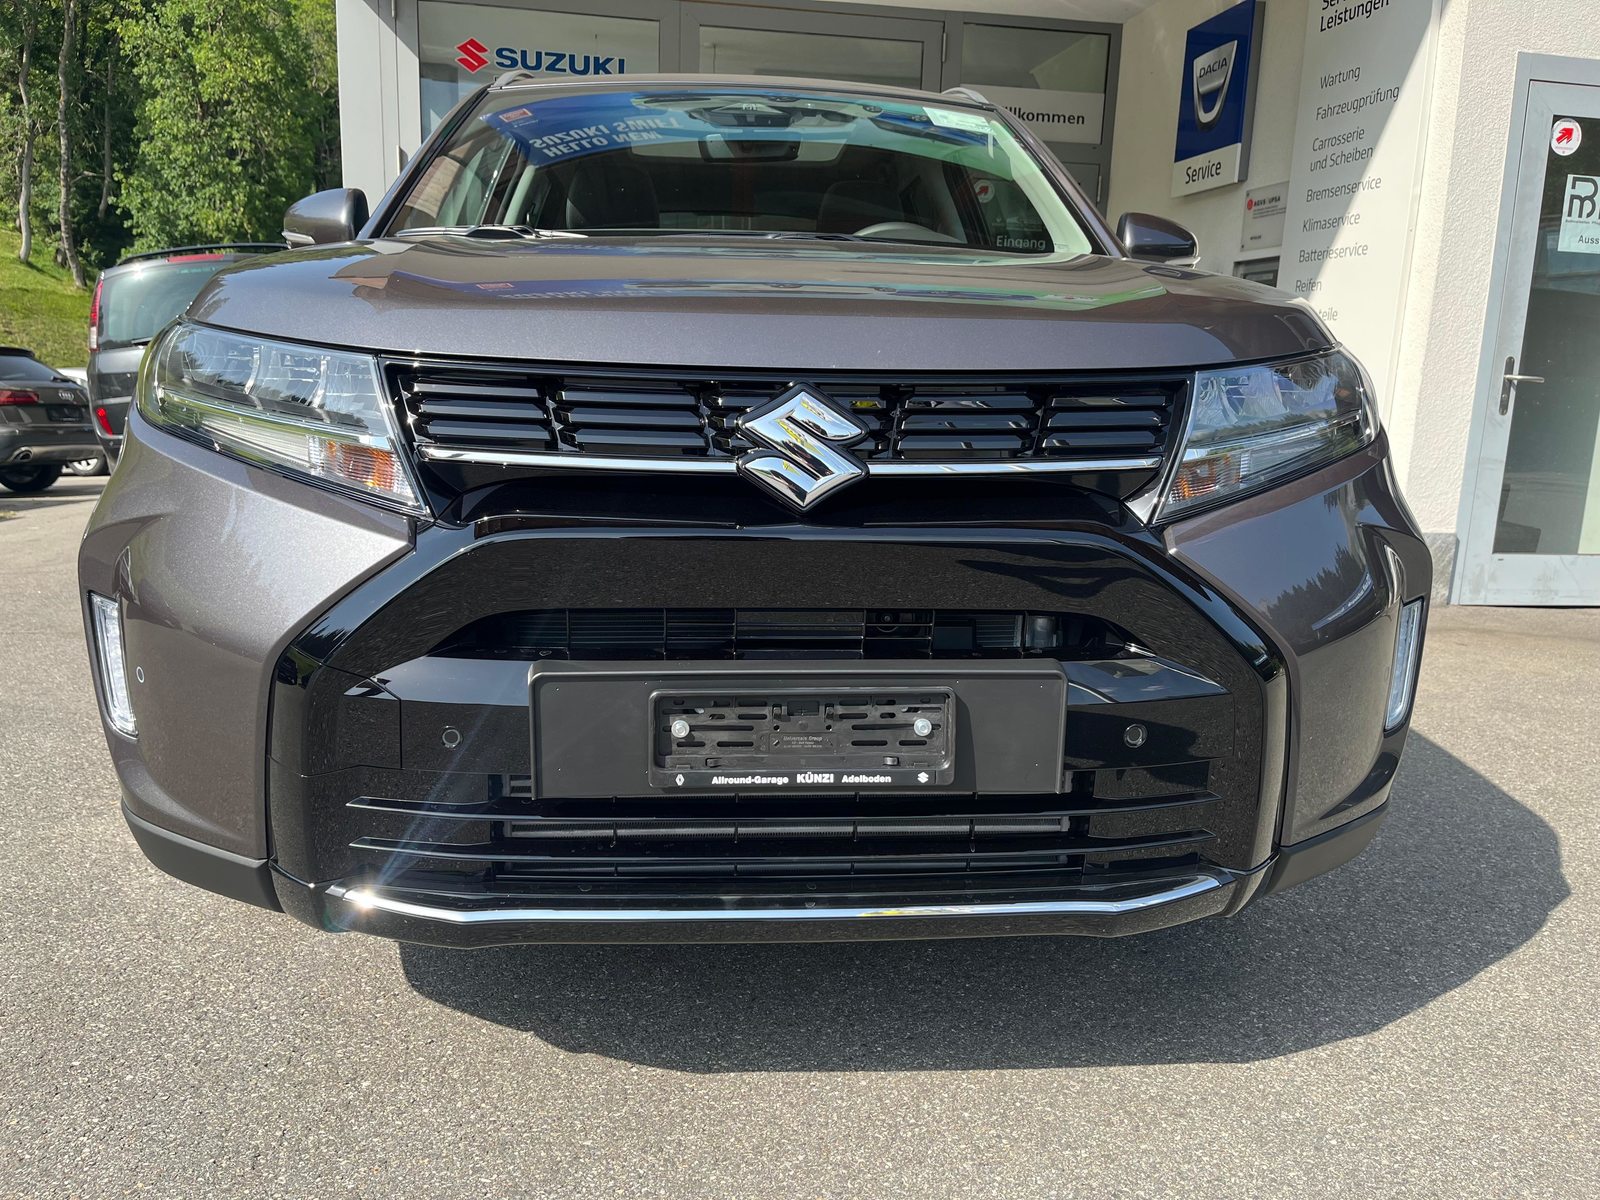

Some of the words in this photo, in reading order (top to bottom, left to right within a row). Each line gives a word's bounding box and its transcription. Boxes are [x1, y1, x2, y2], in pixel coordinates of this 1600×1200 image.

[1320, 0, 1389, 32] Leistungen
[495, 47, 625, 75] SUZUKI
[1199, 57, 1228, 79] DACIA
[1320, 66, 1361, 89] Wartung
[1316, 86, 1400, 121] Fahrzeugprüfung
[1002, 106, 1085, 125] lkommen
[1312, 126, 1365, 152] Carrosserie
[1310, 154, 1328, 172] und
[1329, 147, 1374, 168] Scheiben
[1185, 160, 1222, 184] Service
[1306, 176, 1382, 203] Bremsenservice
[1302, 212, 1361, 233] Klimaservice
[996, 235, 1046, 251] Eingang
[1298, 242, 1369, 263] Batterieservice
[1295, 278, 1322, 293] Reifen
[711, 775, 789, 785] Allround-Garage
[796, 771, 835, 784] KÜNZI
[841, 774, 892, 784] Adelboden
